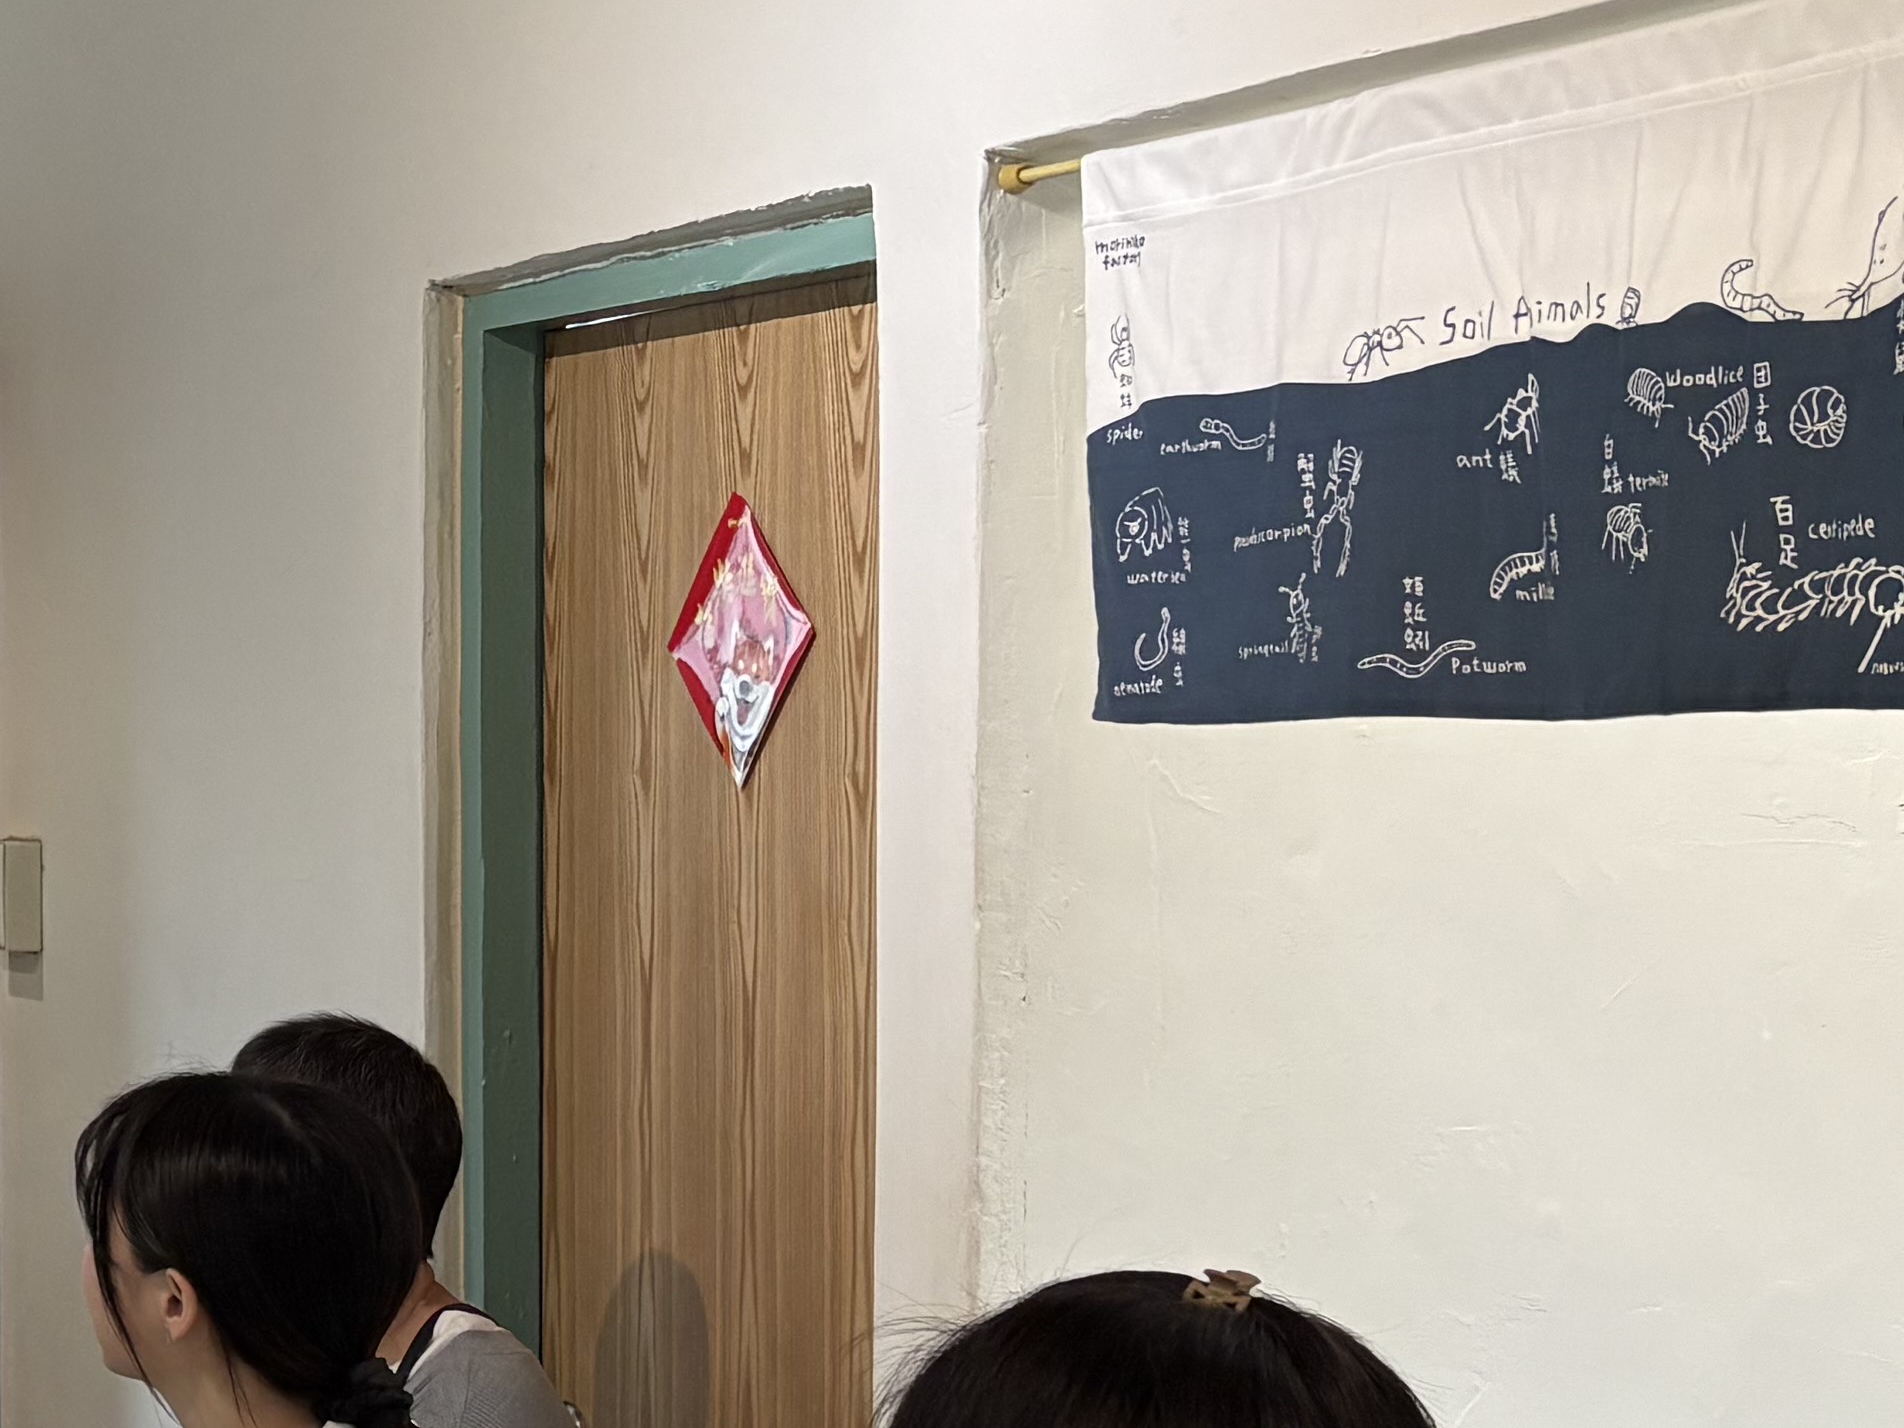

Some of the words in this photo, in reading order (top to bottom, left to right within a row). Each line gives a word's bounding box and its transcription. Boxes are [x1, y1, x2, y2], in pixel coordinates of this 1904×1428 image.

[1439, 299, 1495, 346] Soil
[1665, 365, 1744, 388] Woodlice
[1106, 422, 1144, 446] spider
[1456, 448, 1493, 469] ant
[1769, 495, 1799, 570] 百足
[1451, 656, 1527, 675] Potworm
